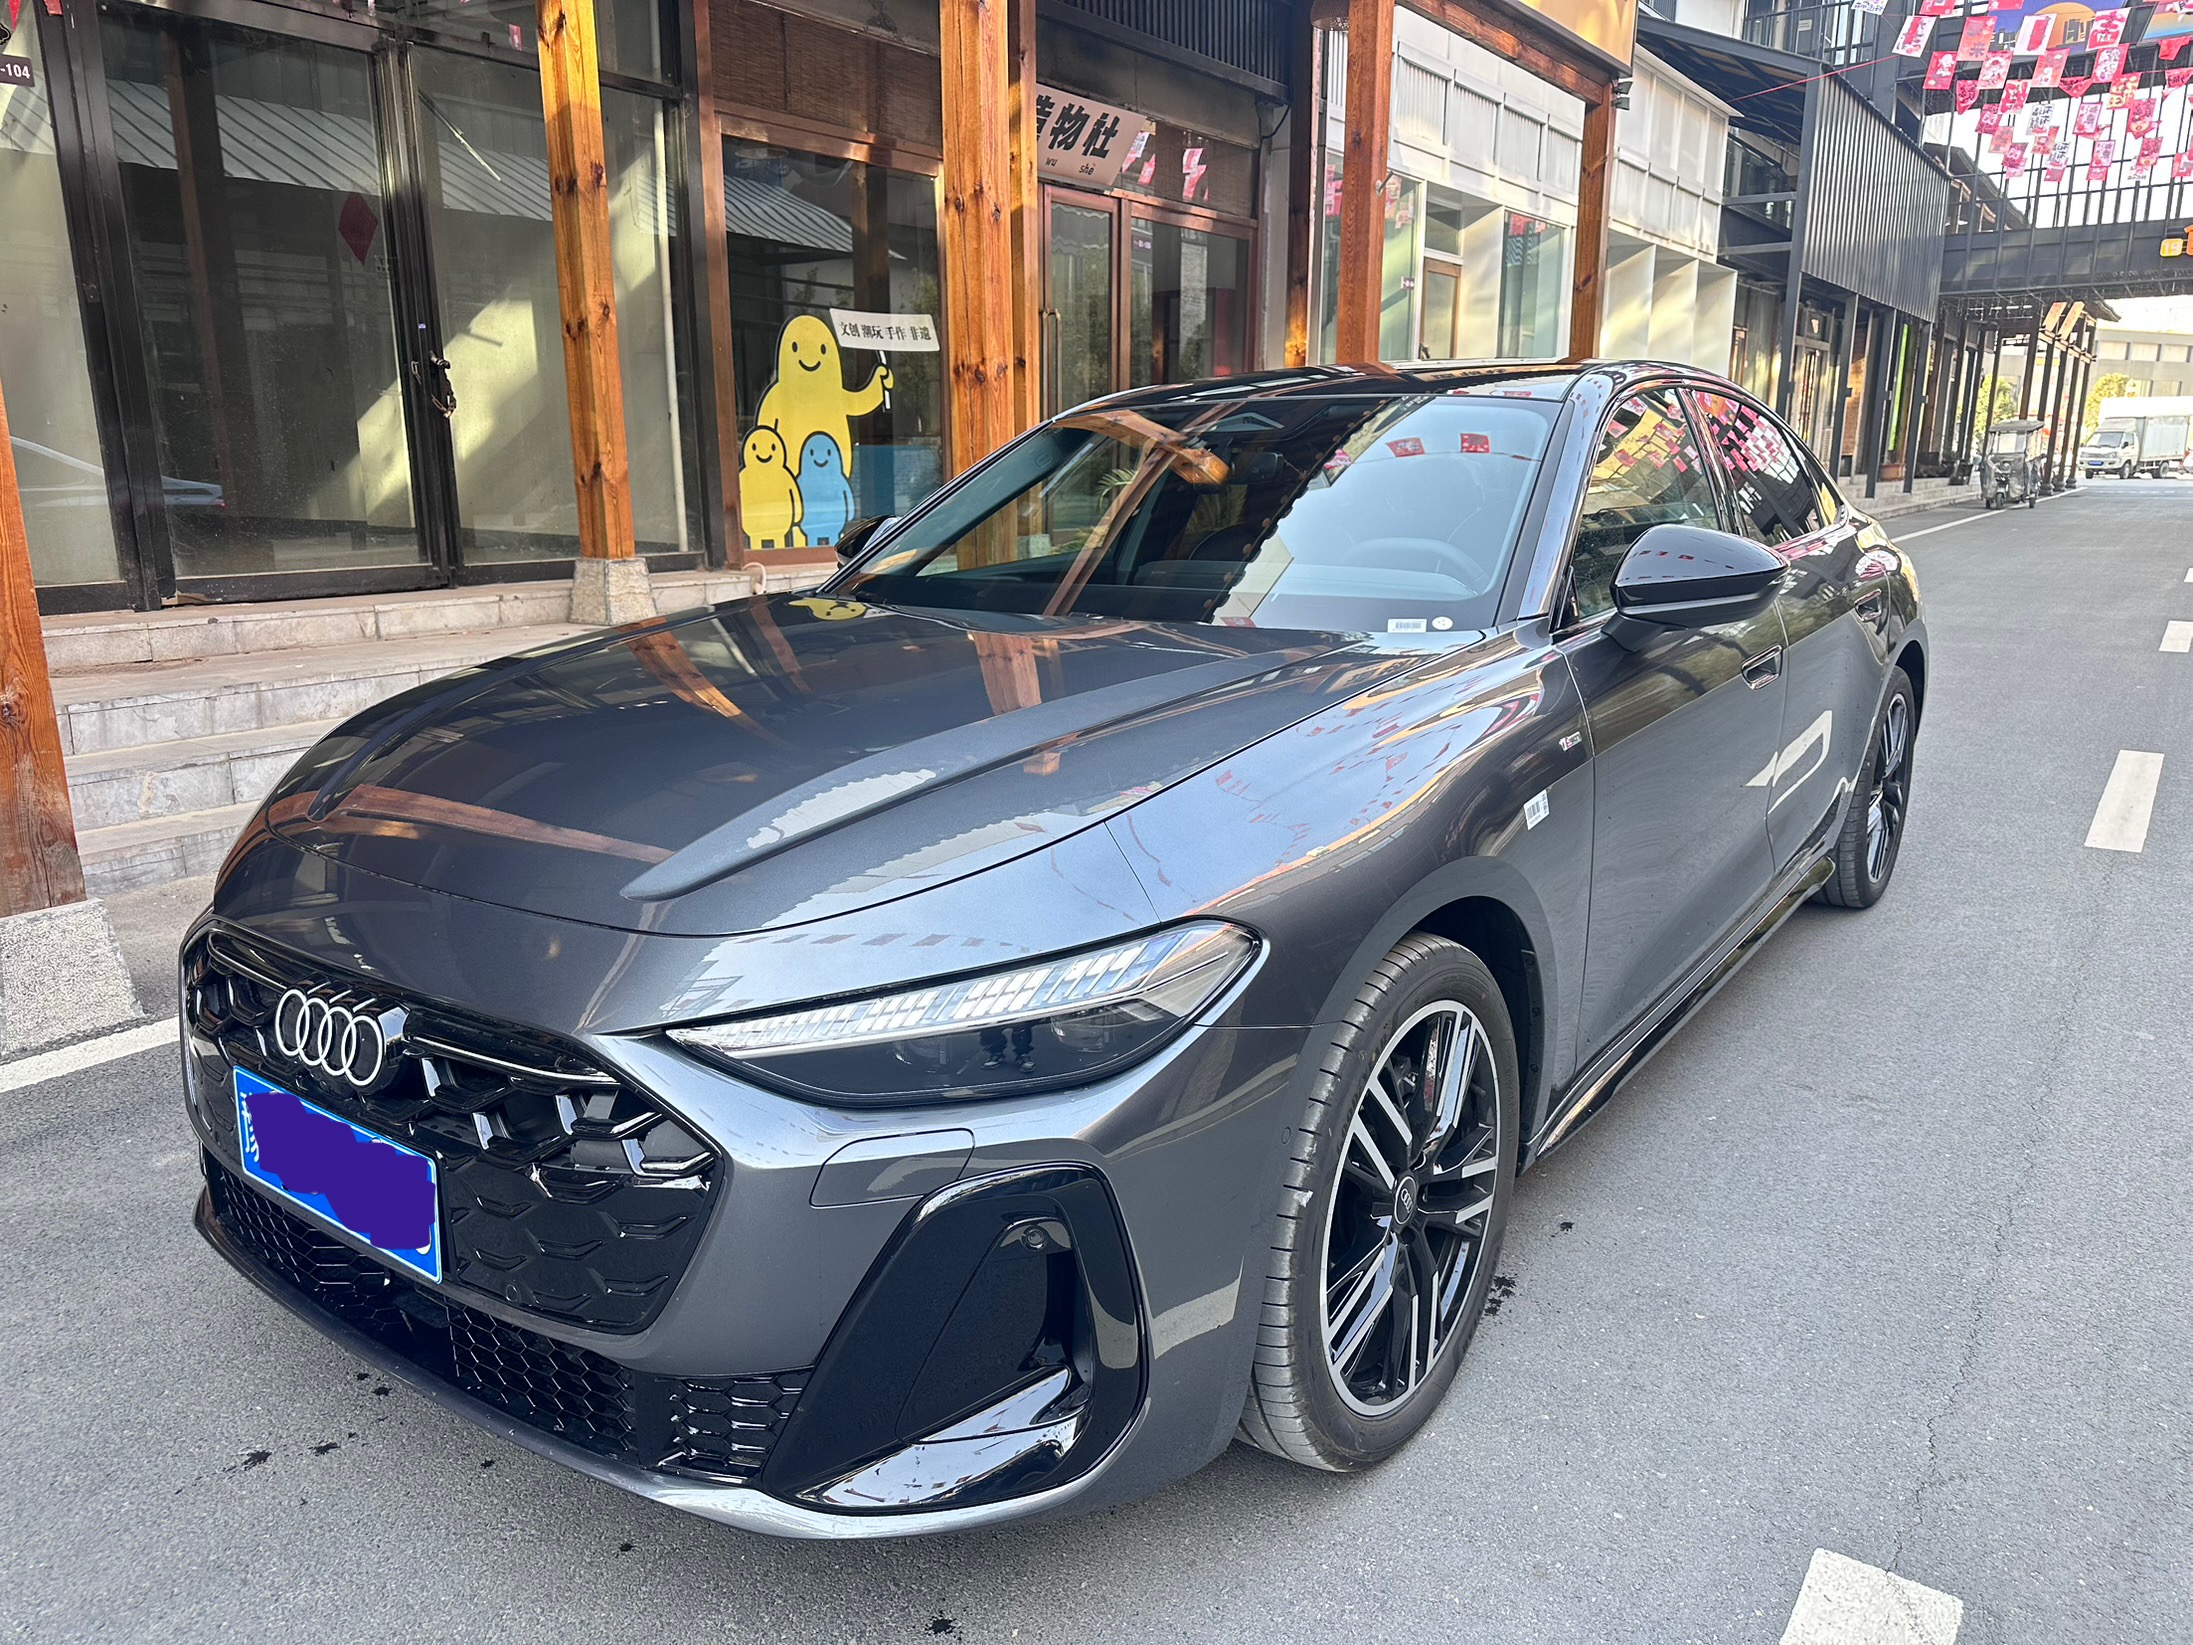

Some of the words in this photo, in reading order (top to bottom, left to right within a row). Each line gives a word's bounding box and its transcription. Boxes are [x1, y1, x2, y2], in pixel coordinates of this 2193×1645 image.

[0, 63, 31, 79] -104
[840, 321, 860, 338] 文创
[861, 324, 884, 340] 潮玩
[885, 325, 907, 341] 手作
[909, 326, 931, 341] 非遗
